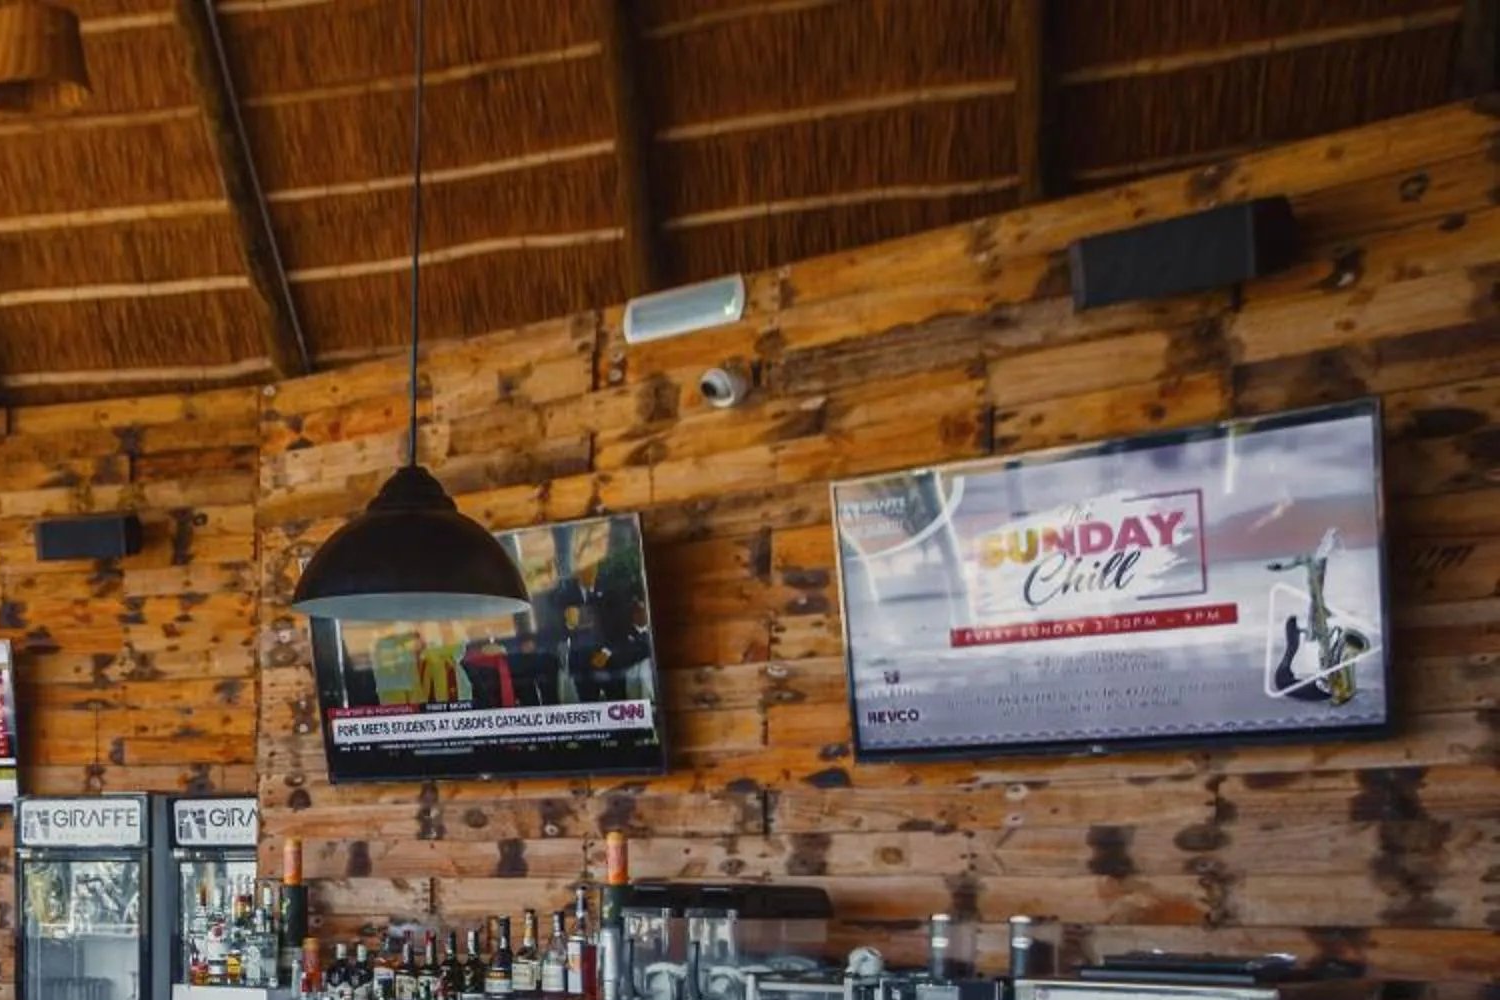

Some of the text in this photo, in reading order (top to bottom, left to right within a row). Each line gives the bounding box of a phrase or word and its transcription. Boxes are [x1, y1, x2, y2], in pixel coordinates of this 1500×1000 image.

[977, 509, 1184, 570] SUNDAY
[1024, 549, 1141, 605] Chill
[965, 627, 1014, 643] EVERY
[1021, 621, 1085, 638] SUNDAY
[338, 709, 602, 737] POPE MEETS STUDENTS AT LISBON'S CATHOLIC UNIVERSITY
[607, 704, 645, 721] CNN
[53, 808, 139, 828] GIRAFFE
